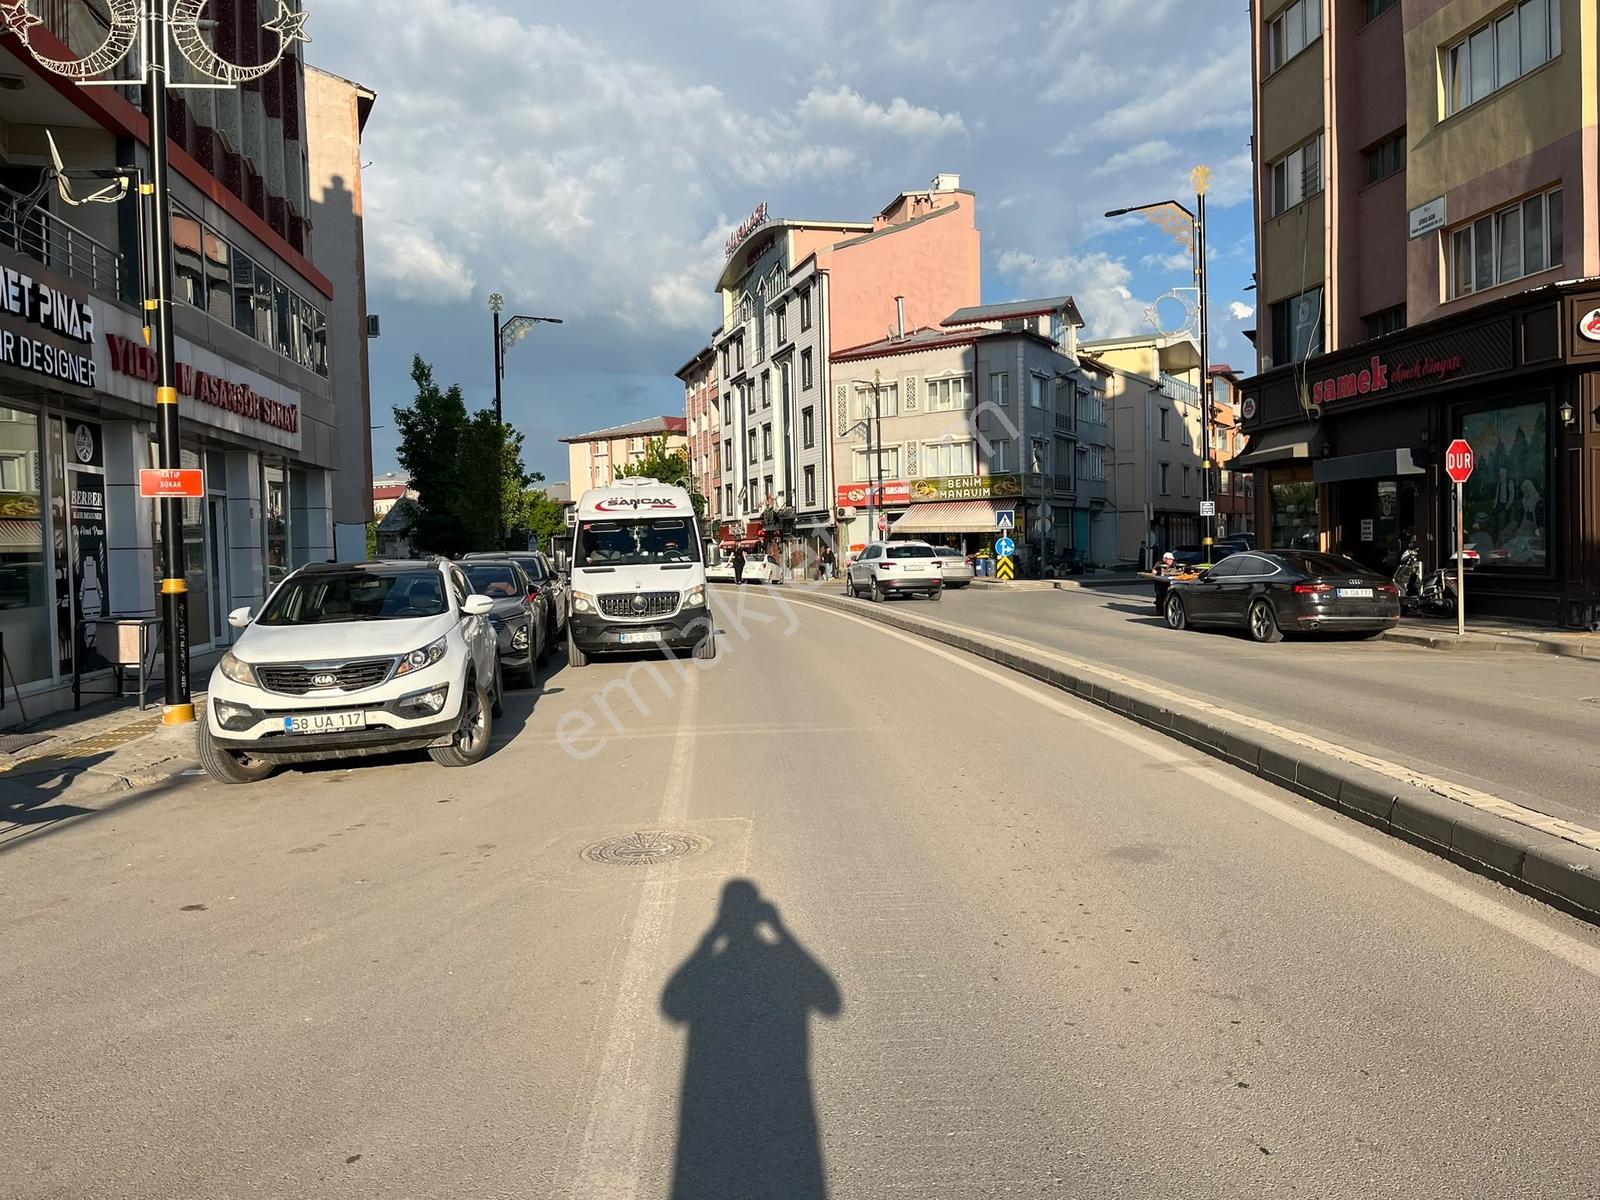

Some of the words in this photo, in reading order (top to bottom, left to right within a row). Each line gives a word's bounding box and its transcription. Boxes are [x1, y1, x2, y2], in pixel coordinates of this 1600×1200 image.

[20, 336, 97, 386] DESIGNER
[106, 333, 193, 397] YILDM
[195, 371, 262, 420] ASANSÖR
[1312, 355, 1388, 404] samek
[1449, 452, 1471, 469] DUR
[159, 480, 182, 488] SOKAK
[947, 477, 982, 488] BENİM
[71, 490, 103, 506] BERBER
[939, 487, 992, 499] MANAVIM
[315, 675, 333, 684] KIA
[292, 718, 309, 730] 58
[314, 716, 333, 728] UA
[339, 713, 361, 726] 117
